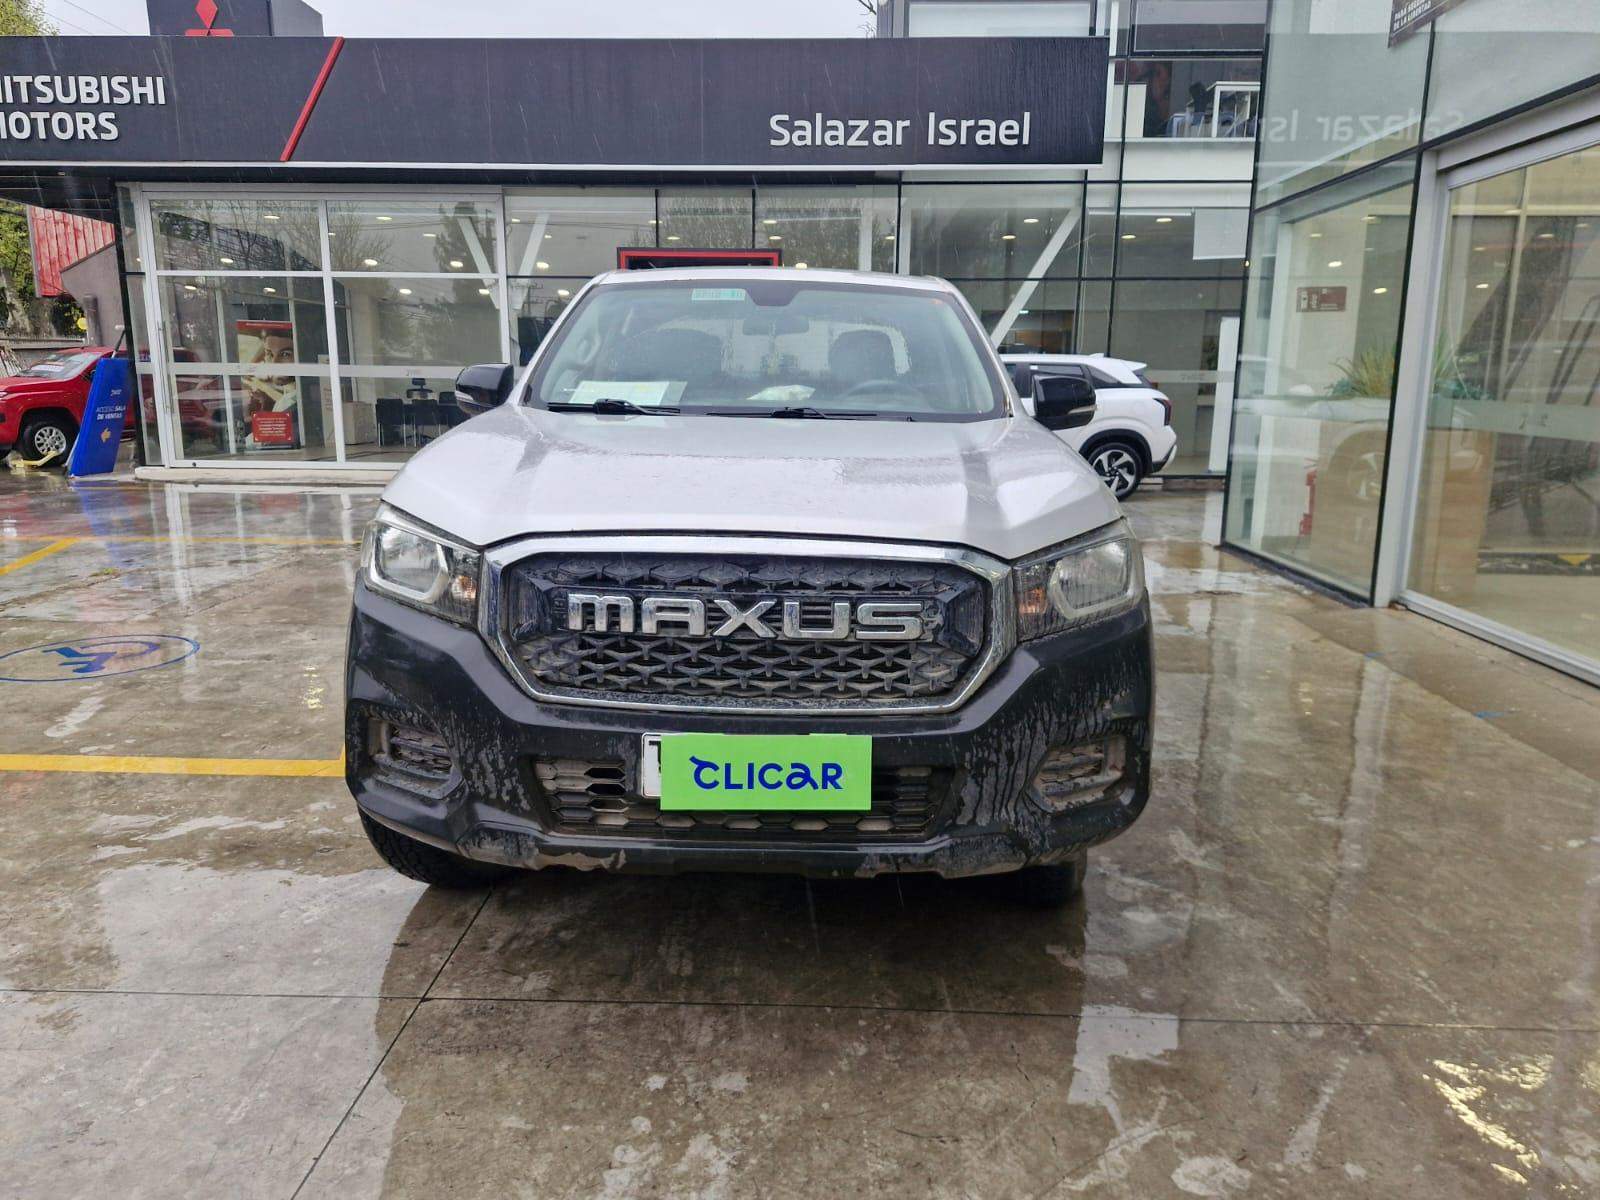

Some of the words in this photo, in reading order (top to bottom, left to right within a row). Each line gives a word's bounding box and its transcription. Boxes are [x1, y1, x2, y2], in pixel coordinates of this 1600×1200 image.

[0, 75, 166, 105] ITSUBISHI
[769, 112, 911, 147] Salazar
[927, 111, 1031, 146] Israel
[568, 593, 924, 640] MAXUS
